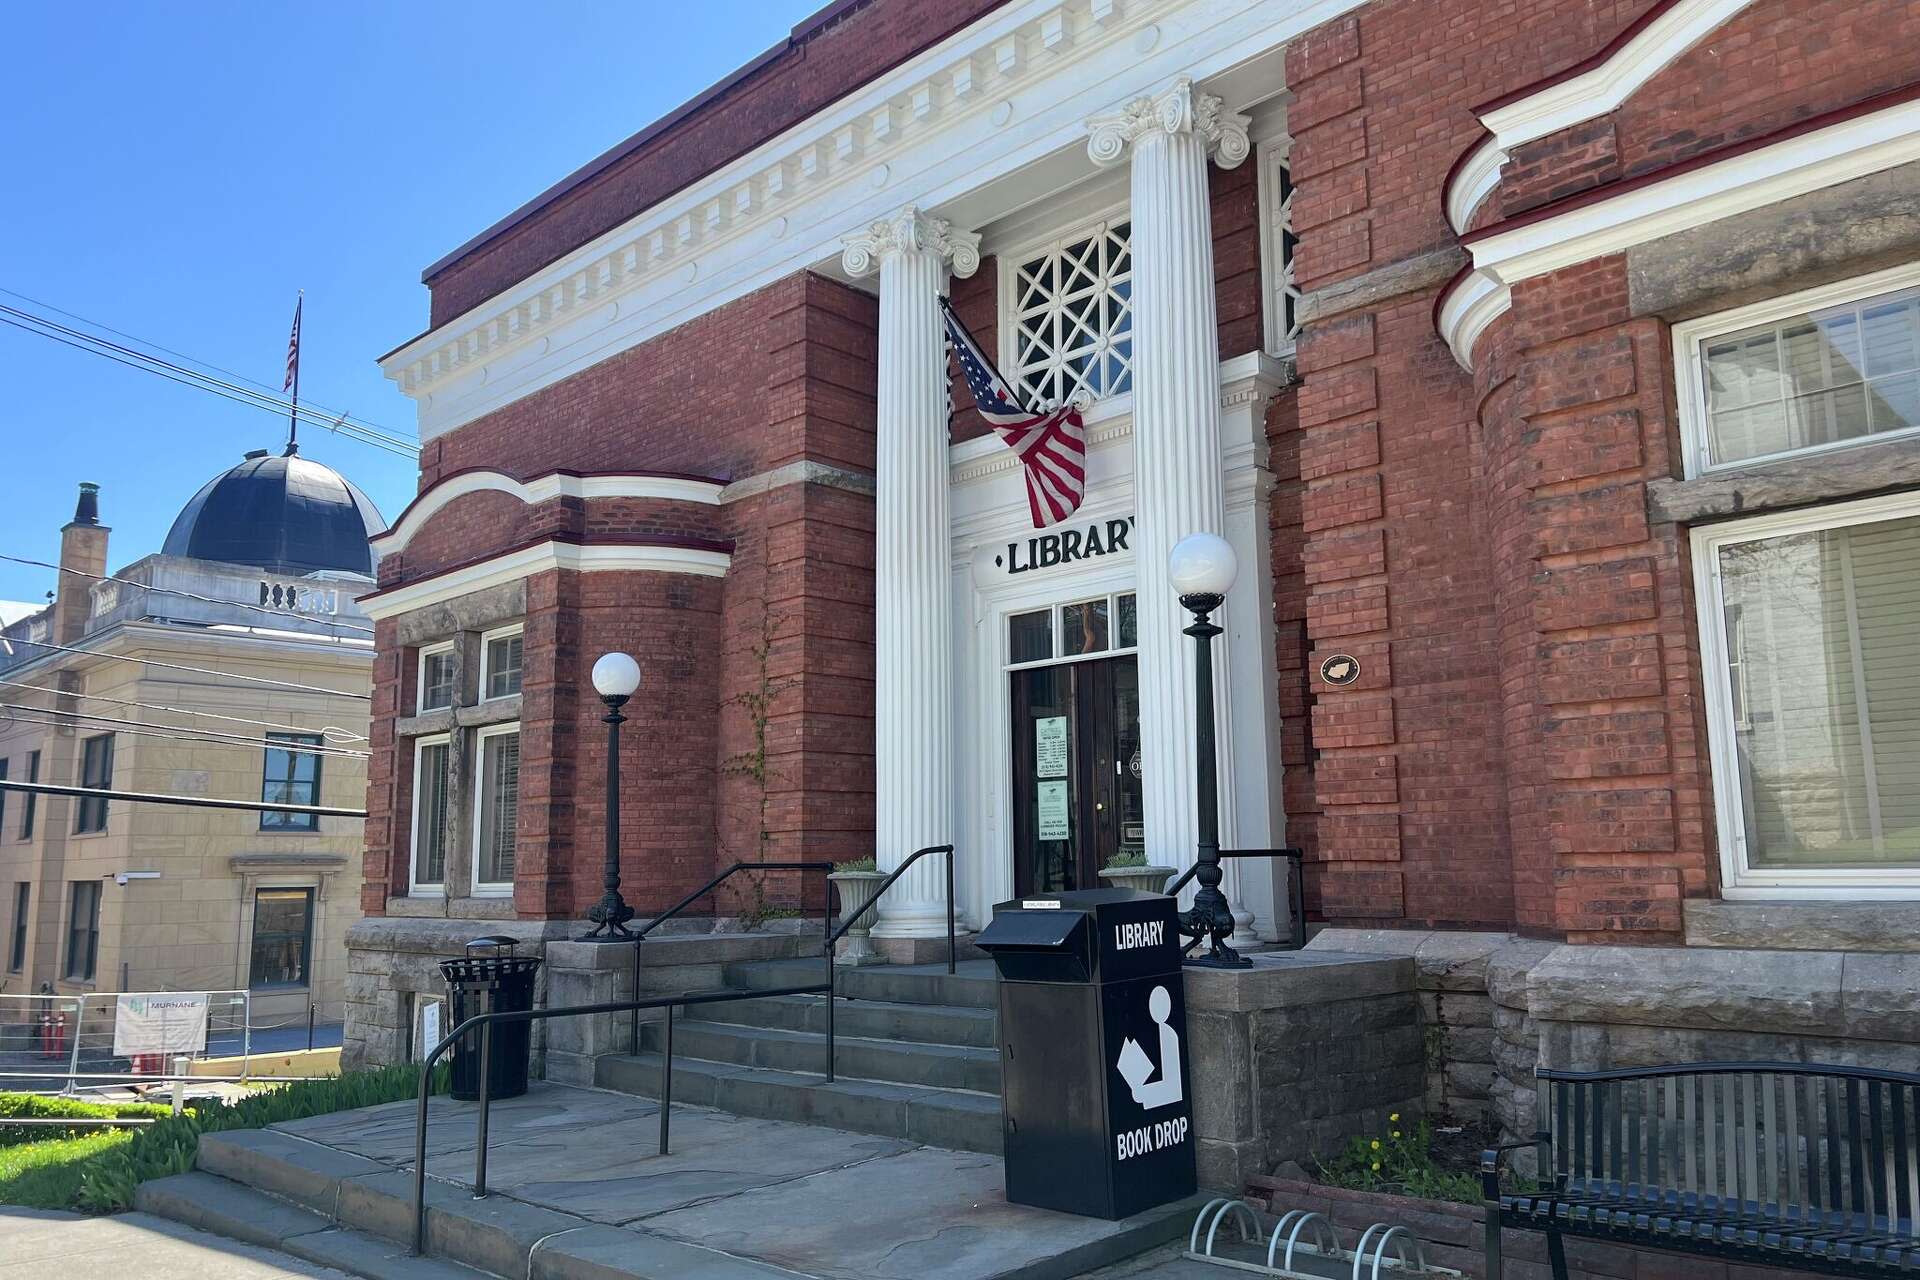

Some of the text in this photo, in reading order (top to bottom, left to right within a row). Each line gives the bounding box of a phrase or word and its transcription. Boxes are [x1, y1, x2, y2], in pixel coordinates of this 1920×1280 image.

[1115, 920, 1164, 950] LIBRARY
[1117, 1116, 1188, 1161] BOOK DROP
